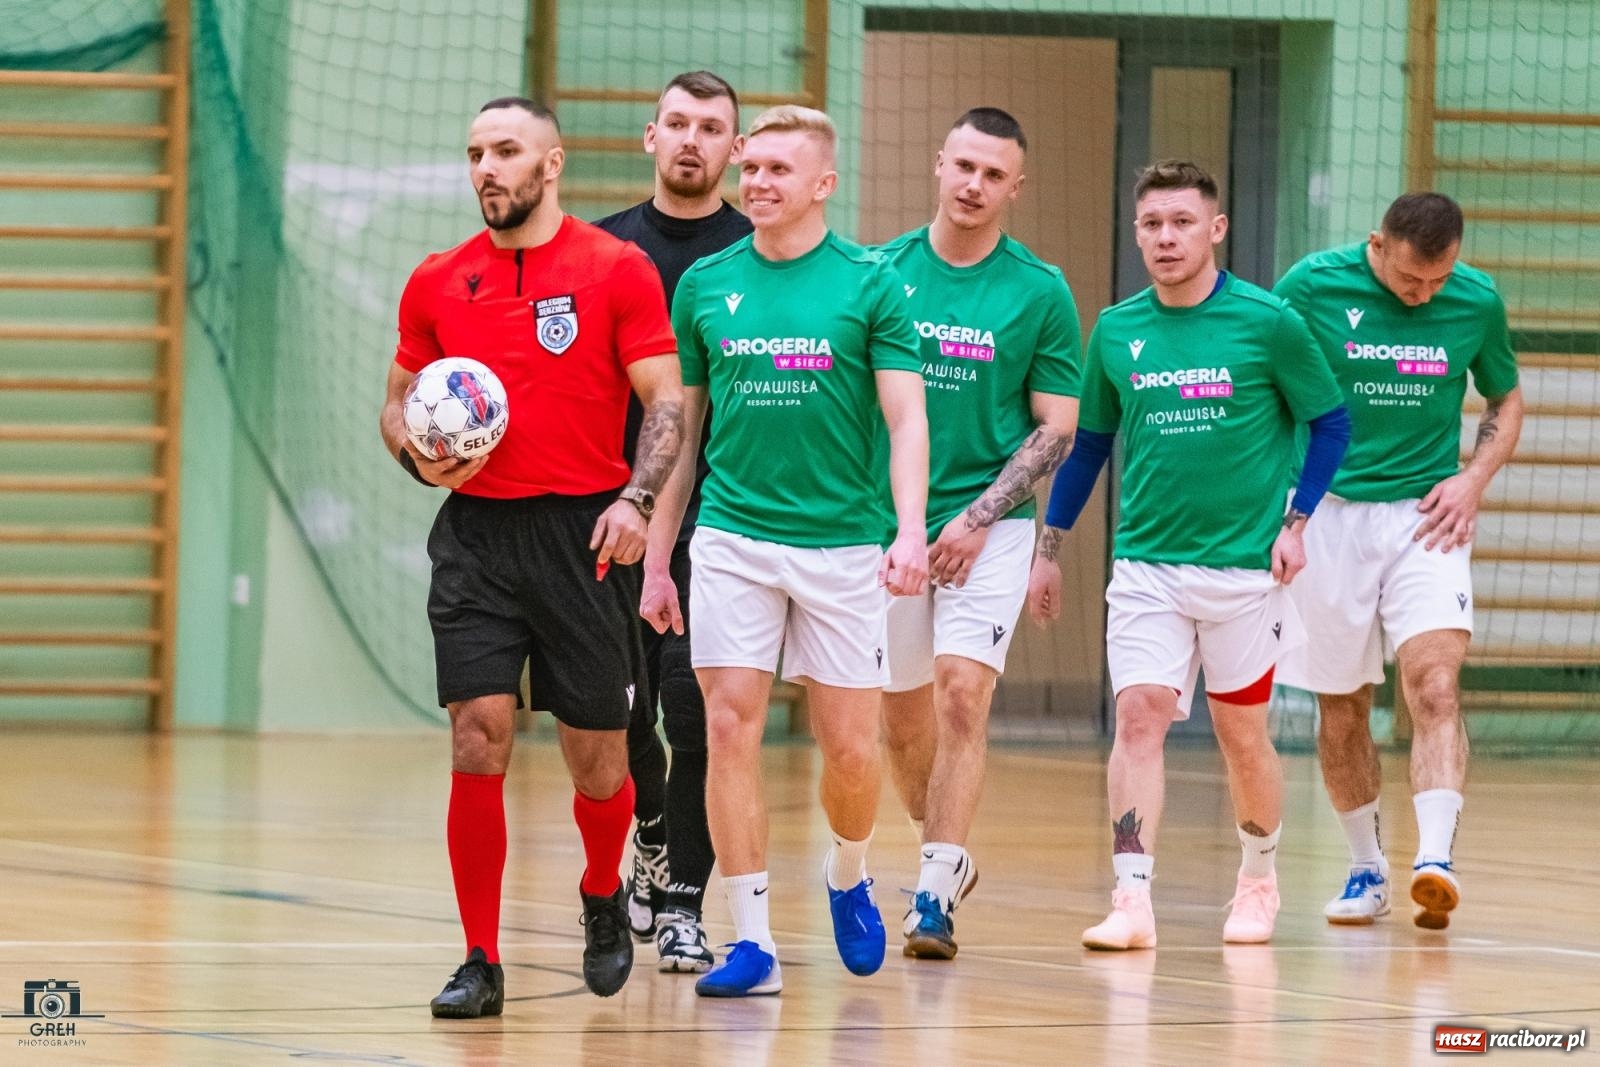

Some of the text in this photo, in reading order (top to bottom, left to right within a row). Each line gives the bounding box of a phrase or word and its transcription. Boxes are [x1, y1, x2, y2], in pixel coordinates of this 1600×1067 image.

[913, 320, 996, 347] OGERIA
[722, 337, 833, 357] DROGERIA
[945, 344, 991, 359] W SIECI
[1346, 344, 1449, 362] DROGERIA
[779, 357, 829, 368] W SIECI
[1402, 363, 1446, 373] W SIECI
[1132, 367, 1233, 391] DROGERIA
[734, 380, 819, 394] NOVAWISŁA
[945, 383, 960, 391] SPA
[1184, 385, 1230, 396] W SIECI
[746, 399, 802, 407] RESORT & SPA
[1368, 398, 1422, 407] RESORT & SPA
[1145, 405, 1227, 425] NOVAWISŁA
[1160, 424, 1212, 436] RESORT & SPA
